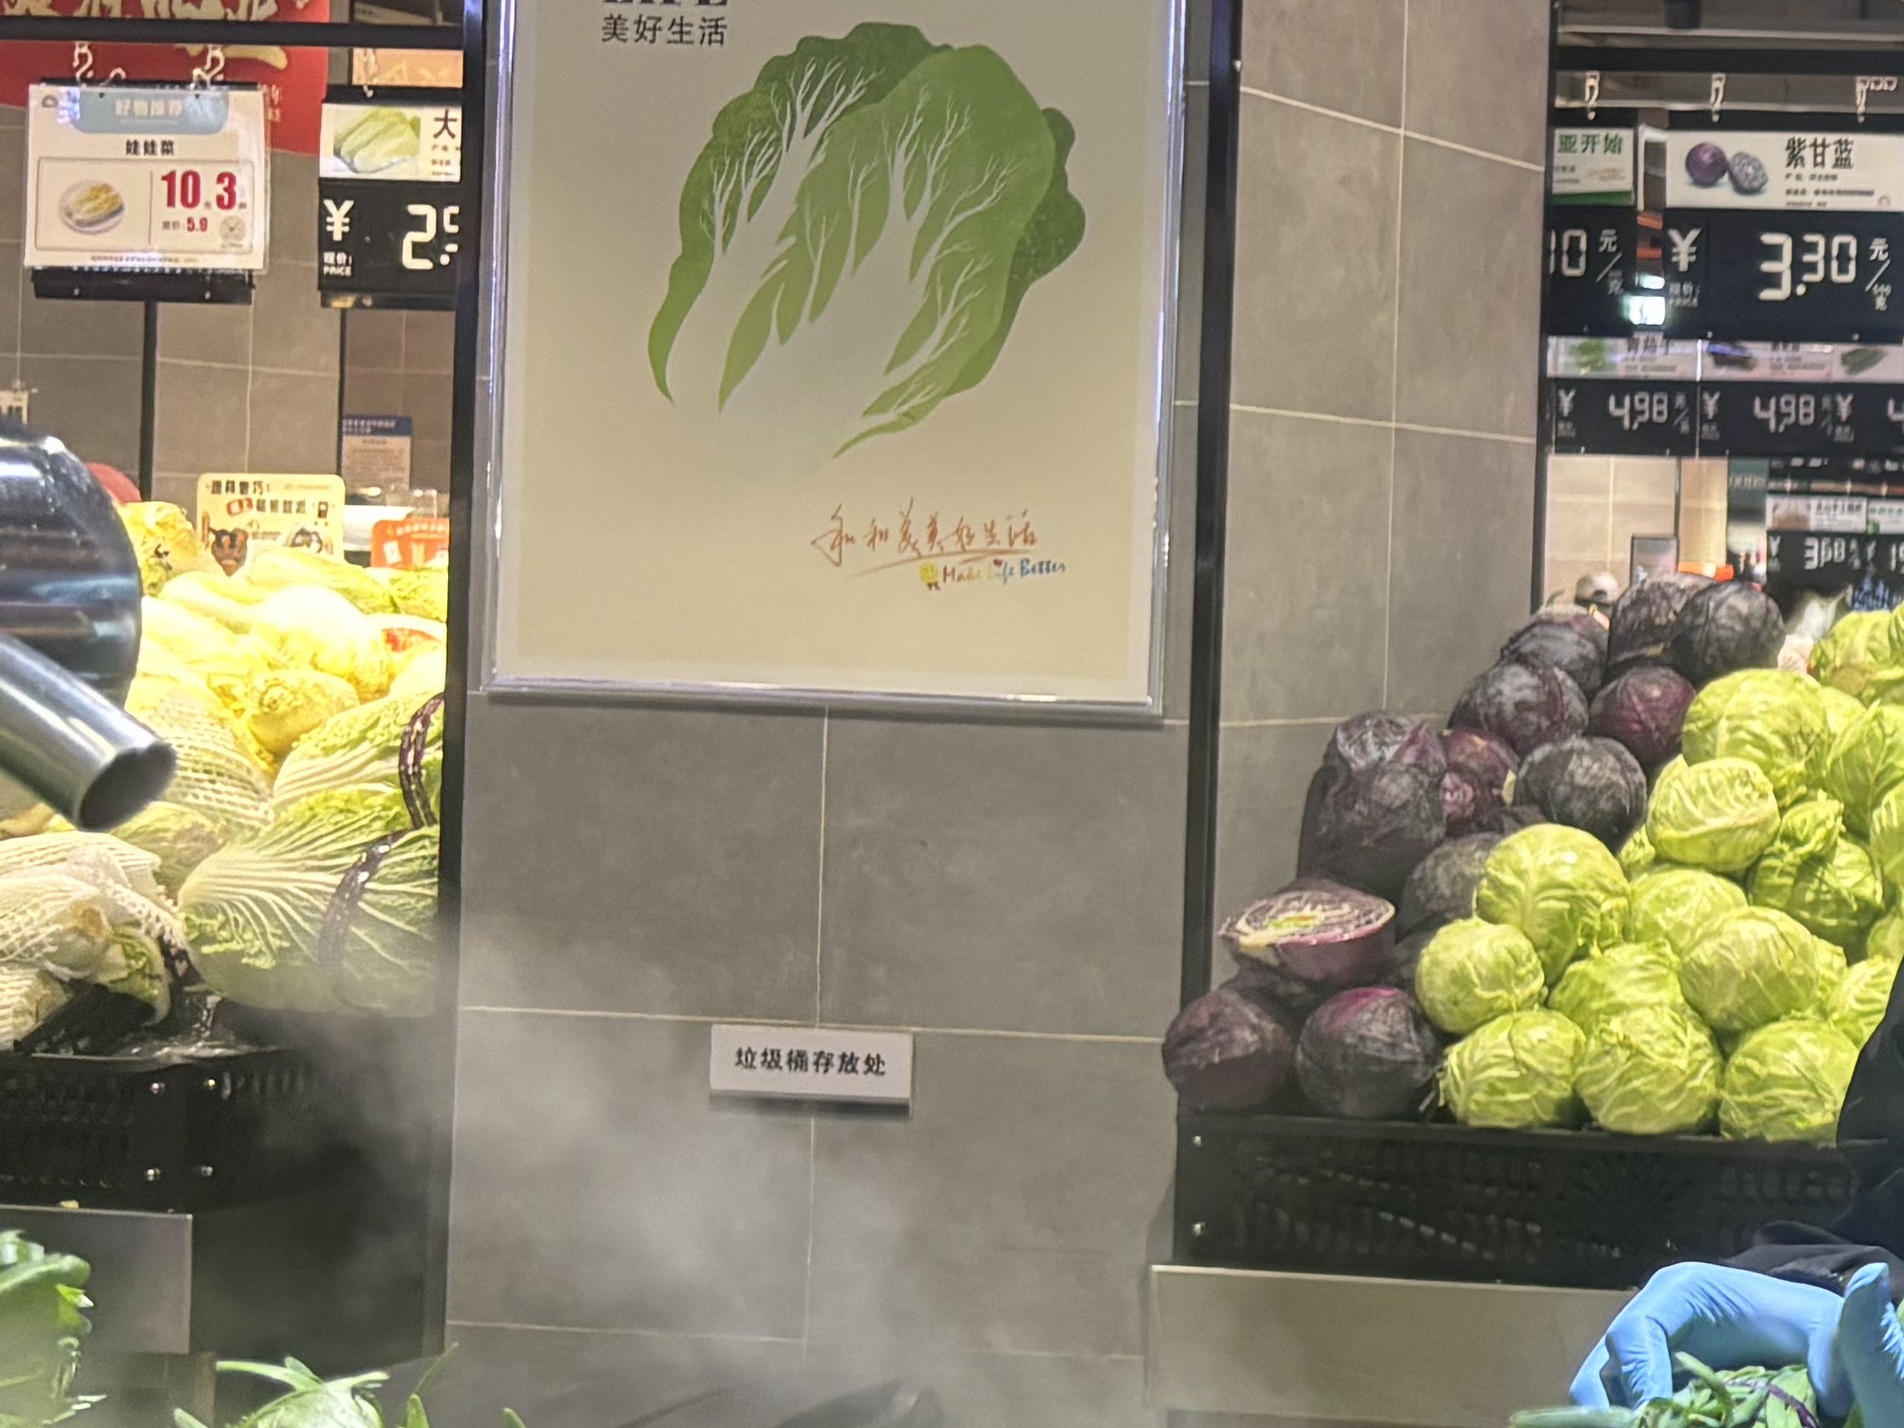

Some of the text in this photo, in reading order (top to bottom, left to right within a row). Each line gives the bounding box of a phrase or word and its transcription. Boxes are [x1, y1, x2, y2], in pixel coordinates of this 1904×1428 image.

[600, 13, 728, 47] 美好生活
[433, 108, 458, 139] 大
[125, 139, 175, 156] 娃娃菜
[1785, 136, 1854, 170] 紫甘蓝
[1758, 232, 1858, 301] 3.30
[1608, 391, 1668, 431] 4.98
[1753, 394, 1815, 433] 4.98
[734, 1045, 887, 1077] 垃圾桶存放处
